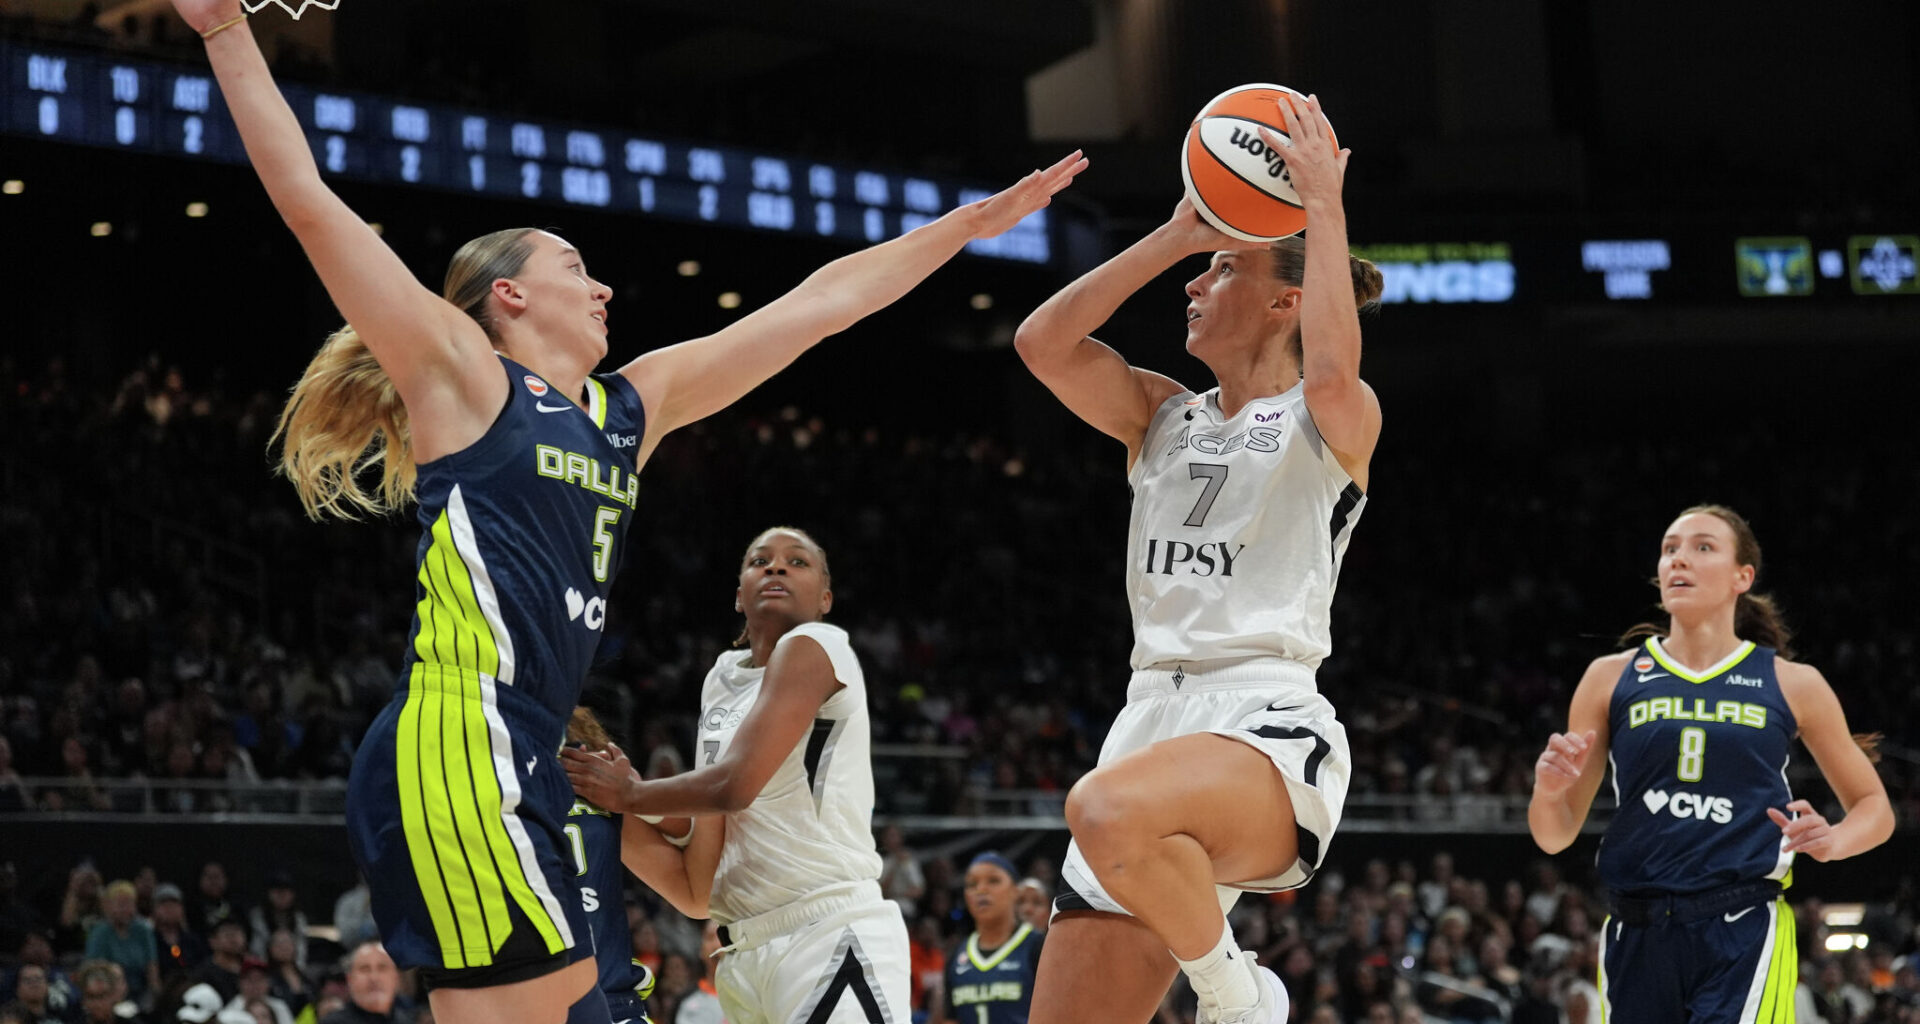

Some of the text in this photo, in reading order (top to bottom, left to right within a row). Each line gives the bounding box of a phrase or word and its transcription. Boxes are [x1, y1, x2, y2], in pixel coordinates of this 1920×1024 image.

[28, 54, 66, 93] BLK
[184, 116, 203, 154] 2
[327, 136, 346, 173] 2
[401, 146, 420, 182] 2
[470, 155, 485, 191] 1
[522, 162, 541, 197] 2
[639, 177, 655, 212] 1
[699, 185, 718, 221] 2
[1377, 261, 1515, 303] INGS
[1255, 410, 1285, 423] ally
[1167, 425, 1282, 456] ACES
[1183, 463, 1229, 528] 7
[592, 505, 622, 582] 5
[1146, 539, 1245, 577] IPSY
[1725, 674, 1763, 688] Albert
[1630, 697, 1767, 729] DALLAS
[1677, 726, 1706, 783] 8
[1669, 792, 1733, 824] CVS
